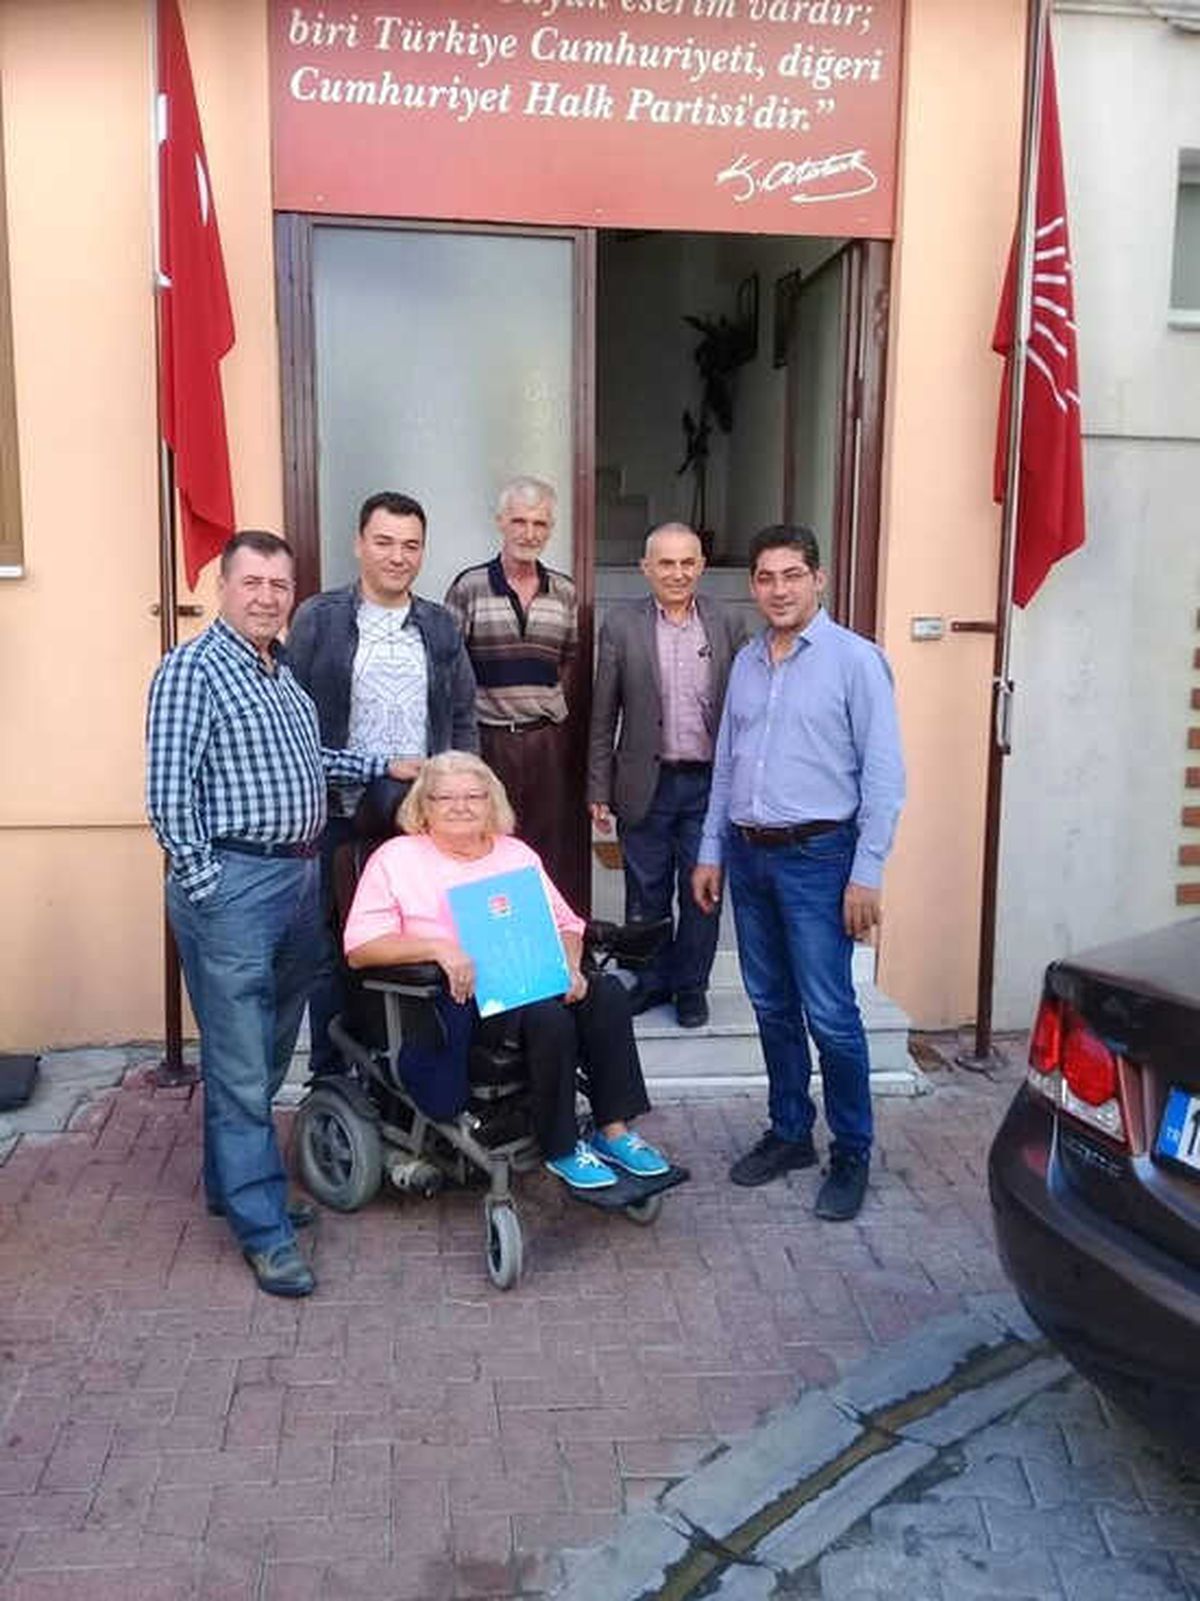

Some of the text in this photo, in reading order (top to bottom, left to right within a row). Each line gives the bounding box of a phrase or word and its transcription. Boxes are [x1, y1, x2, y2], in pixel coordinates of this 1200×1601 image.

[750, 0, 873, 35] vardır;
[289, 9, 884, 90] biri Türkiye Cumhuriyeti, diğeri
[290, 66, 512, 122] Cumhuriyet
[523, 80, 613, 120] Halk
